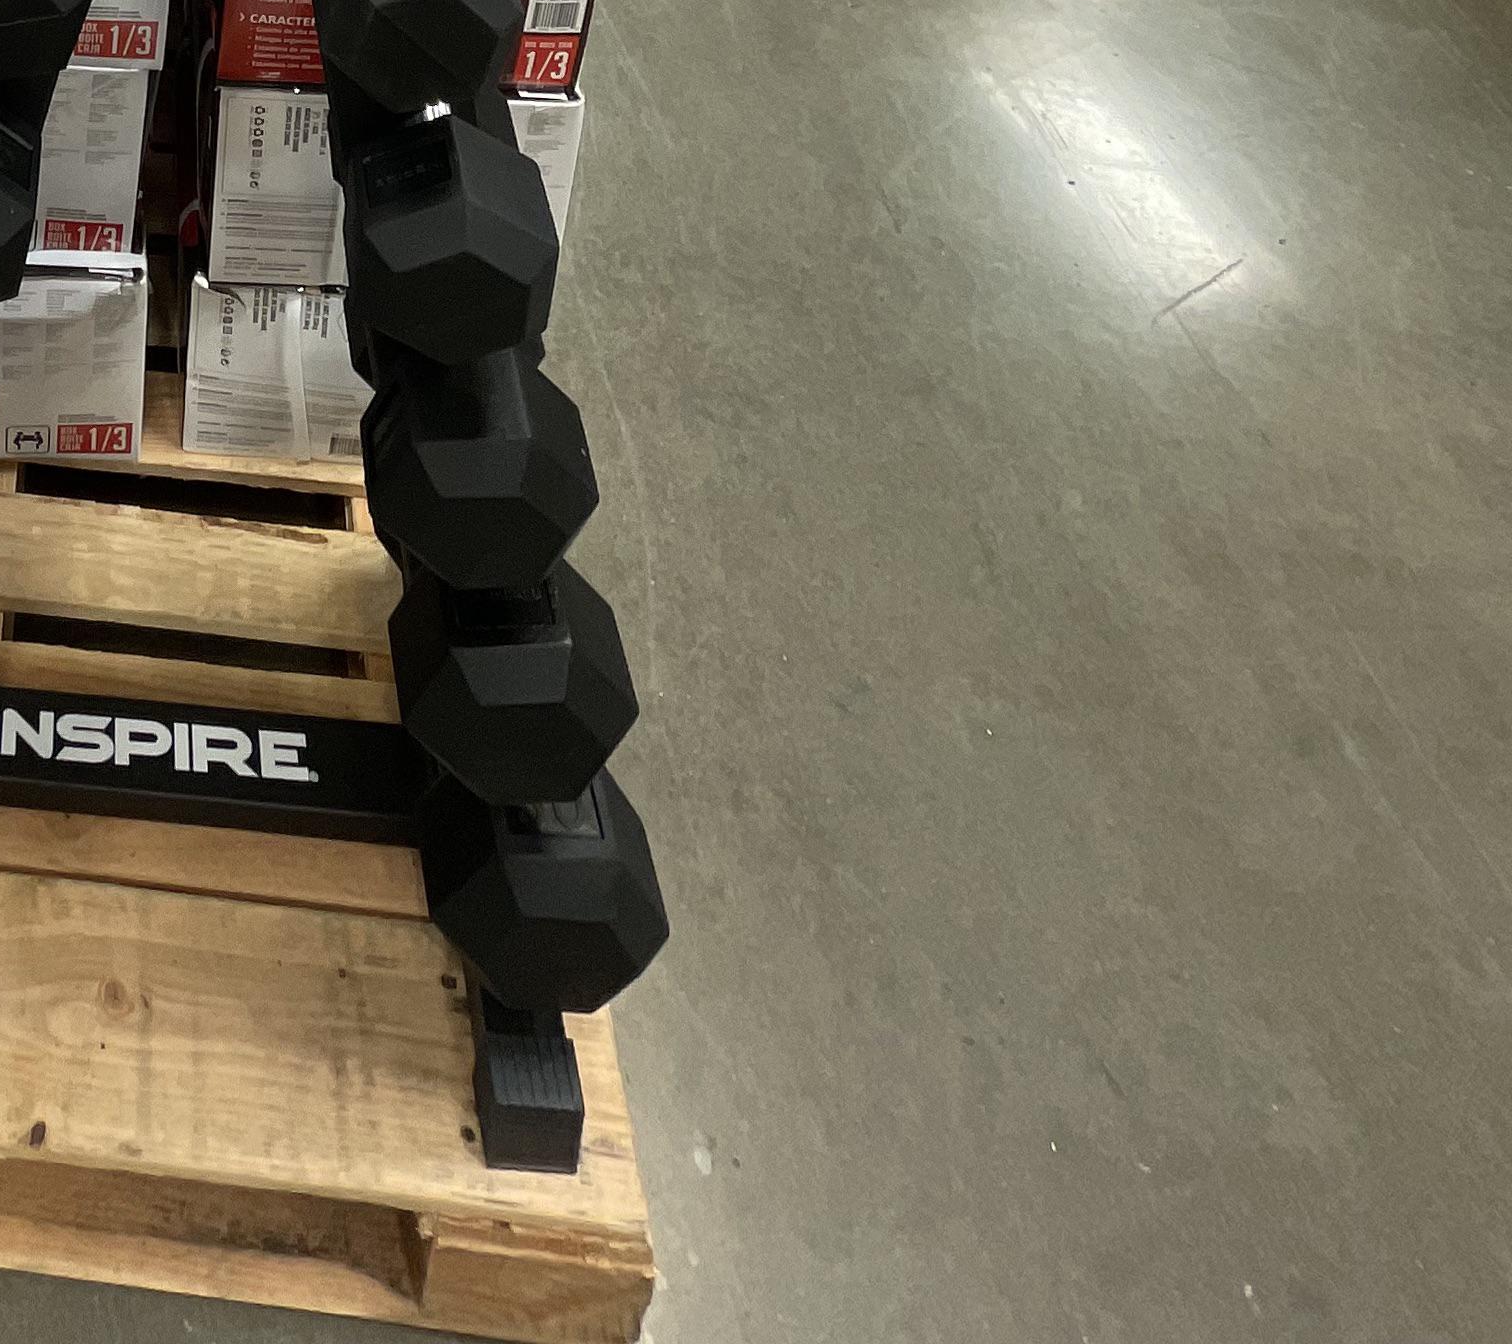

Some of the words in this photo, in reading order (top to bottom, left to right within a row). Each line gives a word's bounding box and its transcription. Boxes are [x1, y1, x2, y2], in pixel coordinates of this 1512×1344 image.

[110, 25, 151, 57] 1/3
[525, 52, 569, 80] 1/3
[89, 428, 128, 452] 1/3
